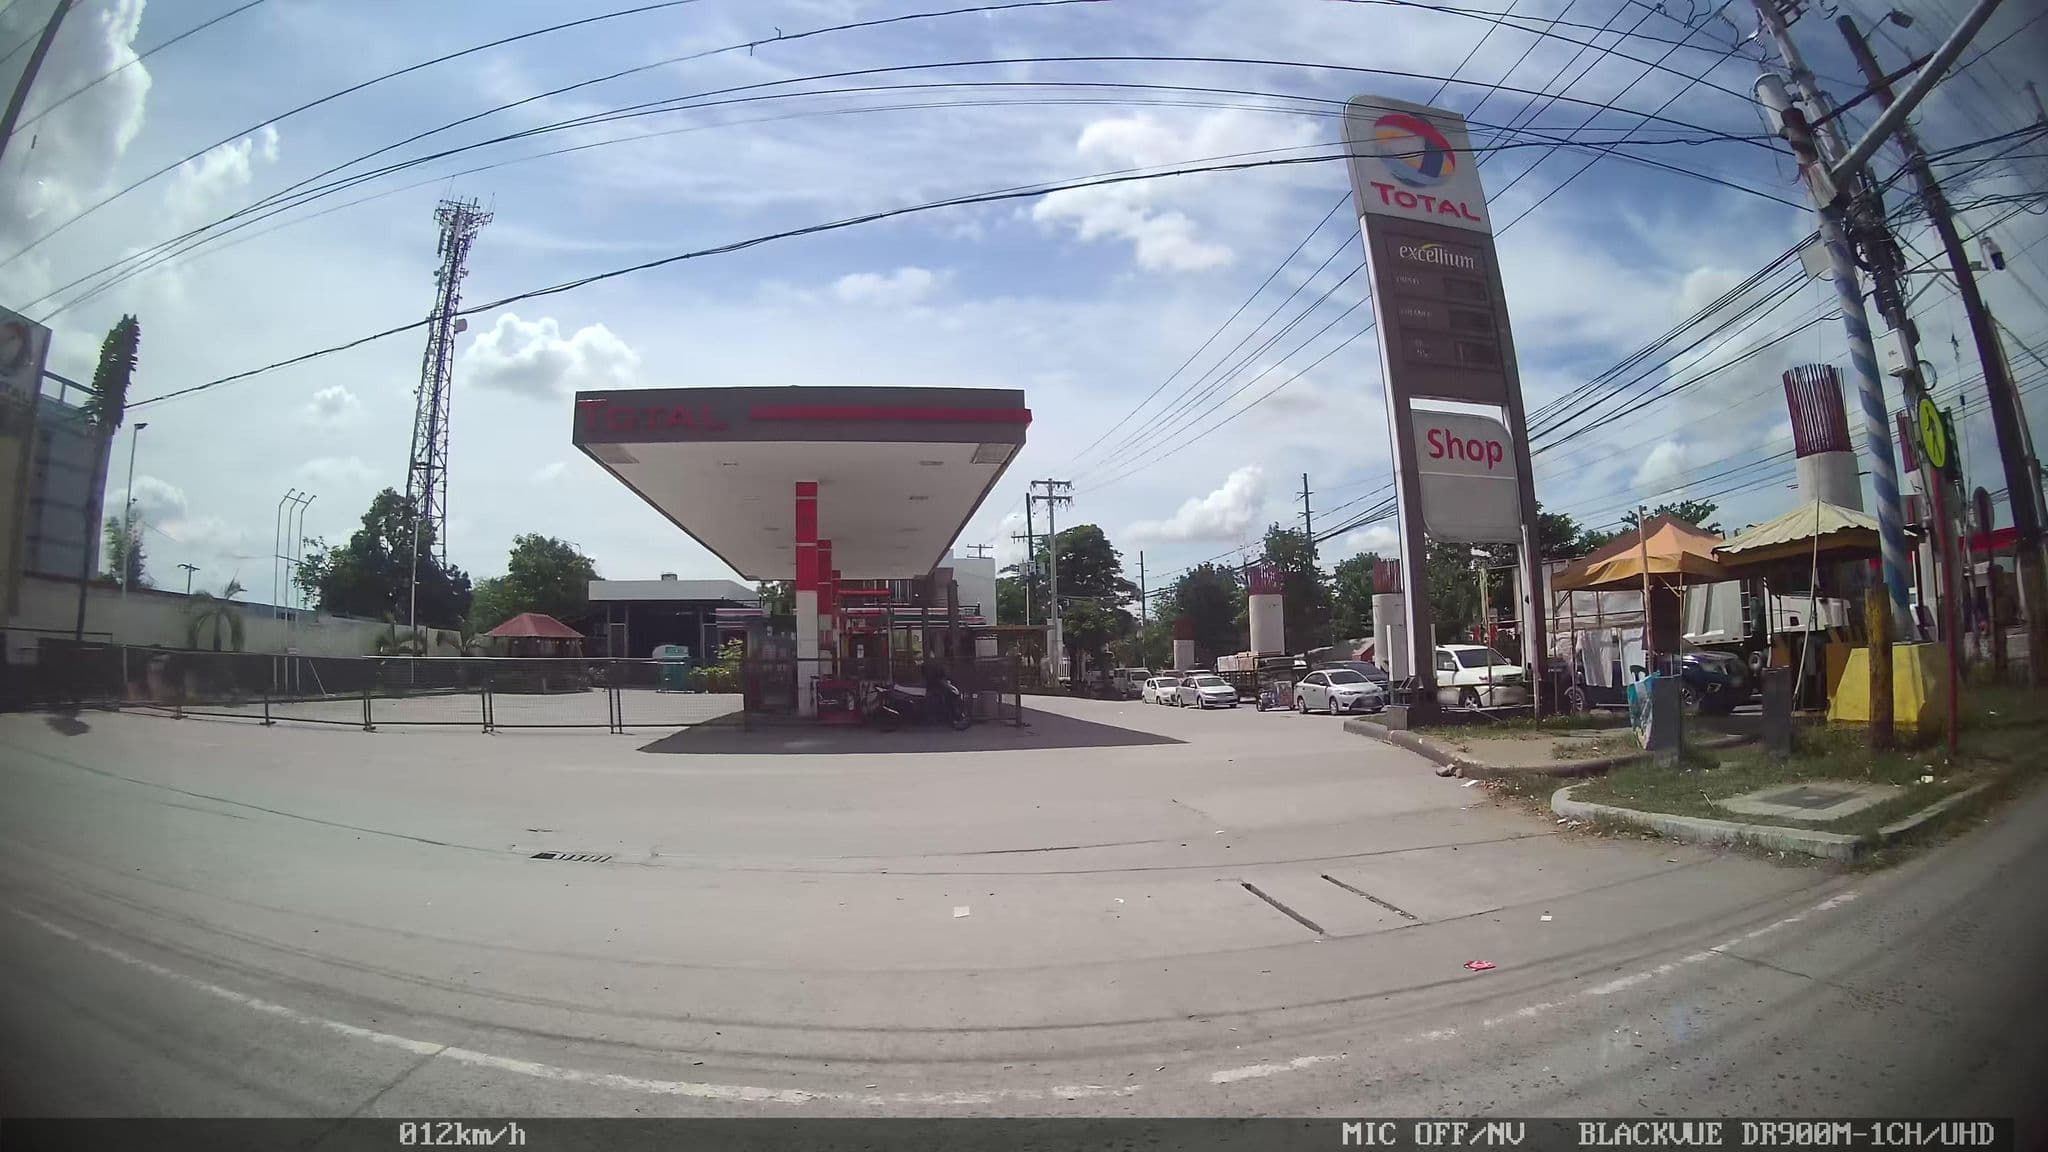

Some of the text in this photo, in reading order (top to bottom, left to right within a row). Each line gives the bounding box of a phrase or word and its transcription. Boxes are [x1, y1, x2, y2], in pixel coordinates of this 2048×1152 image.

[1370, 181, 1481, 222] TOTAL
[1399, 245, 1474, 270] excellium
[577, 400, 729, 432] TOTAL
[1427, 427, 1503, 470] Shop
